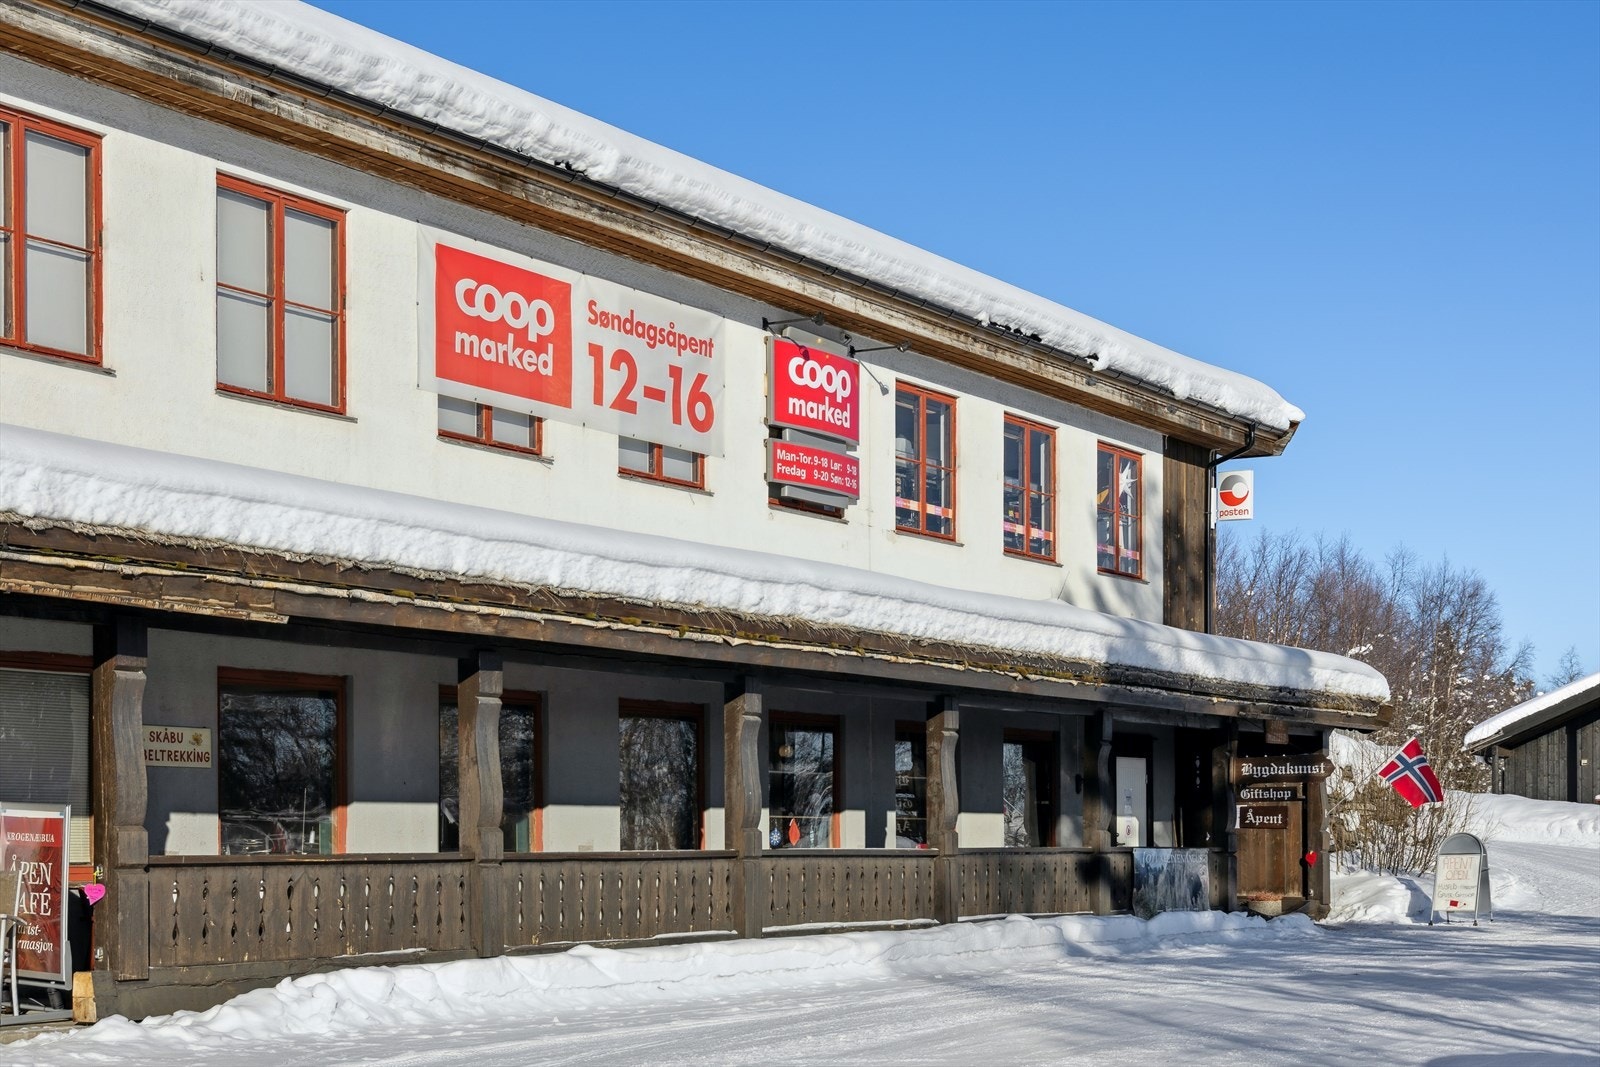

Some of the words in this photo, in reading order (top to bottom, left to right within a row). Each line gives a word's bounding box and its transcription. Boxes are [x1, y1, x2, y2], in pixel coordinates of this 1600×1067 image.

[455, 279, 555, 343] coop
[588, 299, 714, 358] Søndagsåpent
[455, 330, 553, 377] marked
[588, 342, 715, 433] 12-16
[788, 356, 851, 403] coop
[788, 396, 850, 428] marked
[813, 456, 828, 468] 9-18
[776, 463, 806, 480] Fredag
[813, 469, 829, 481] 9-20
[1219, 508, 1249, 518] posten
[149, 728, 184, 744] SKÅBU
[144, 748, 210, 763] BELTREKKING
[1241, 762, 1326, 778] Bygdakunst
[1240, 788, 1291, 800] Giftshop
[1244, 808, 1283, 825] Åpent
[18, 887, 52, 917] AFÉ
[17, 938, 54, 953] rmasjon
